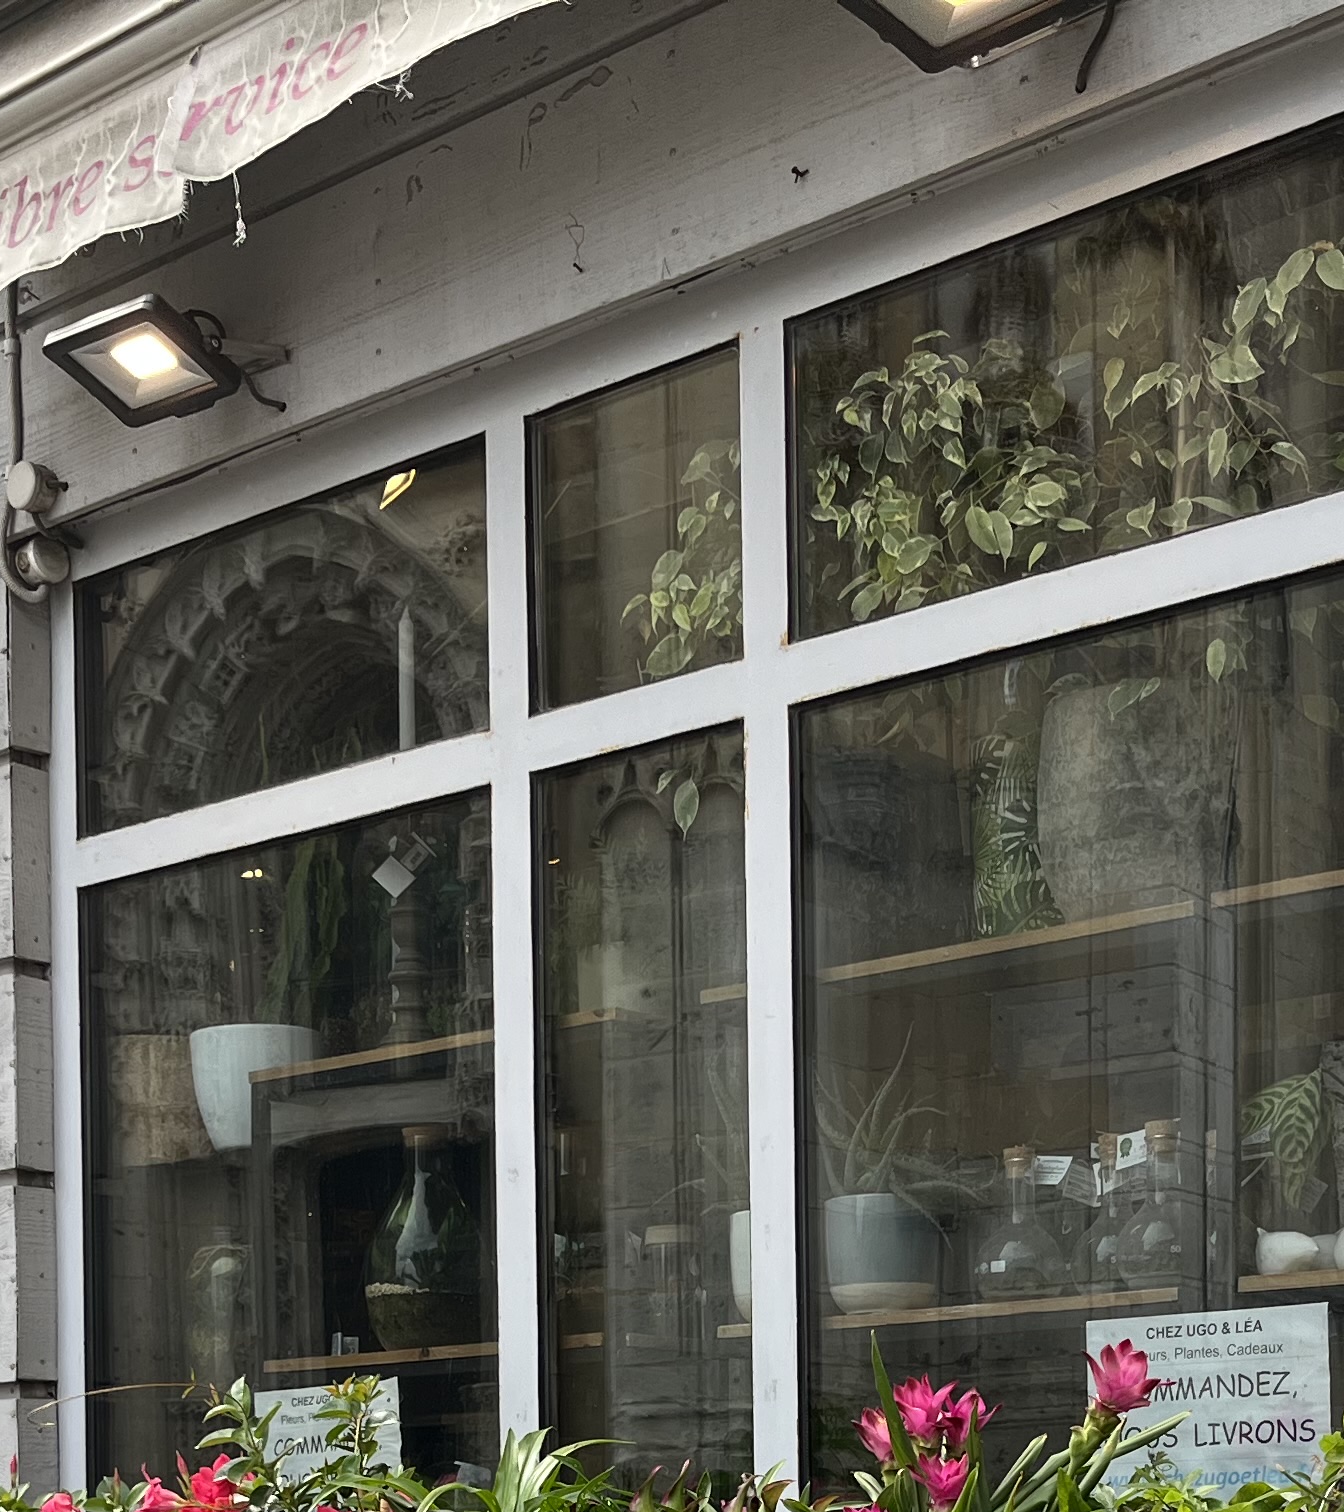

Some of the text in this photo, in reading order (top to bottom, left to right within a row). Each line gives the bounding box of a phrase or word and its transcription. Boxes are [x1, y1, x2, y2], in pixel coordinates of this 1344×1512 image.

[123, 20, 369, 194] srvice
[1146, 1317, 1263, 1340] CHEZ UGO & LÉA
[1174, 1347, 1223, 1361] Plantes,
[1226, 1342, 1284, 1357] Cadeaux
[1151, 1370, 1298, 1402] MMANDEZ,
[291, 1395, 315, 1408] CHEZ
[1194, 1418, 1316, 1448] LIVRONS
